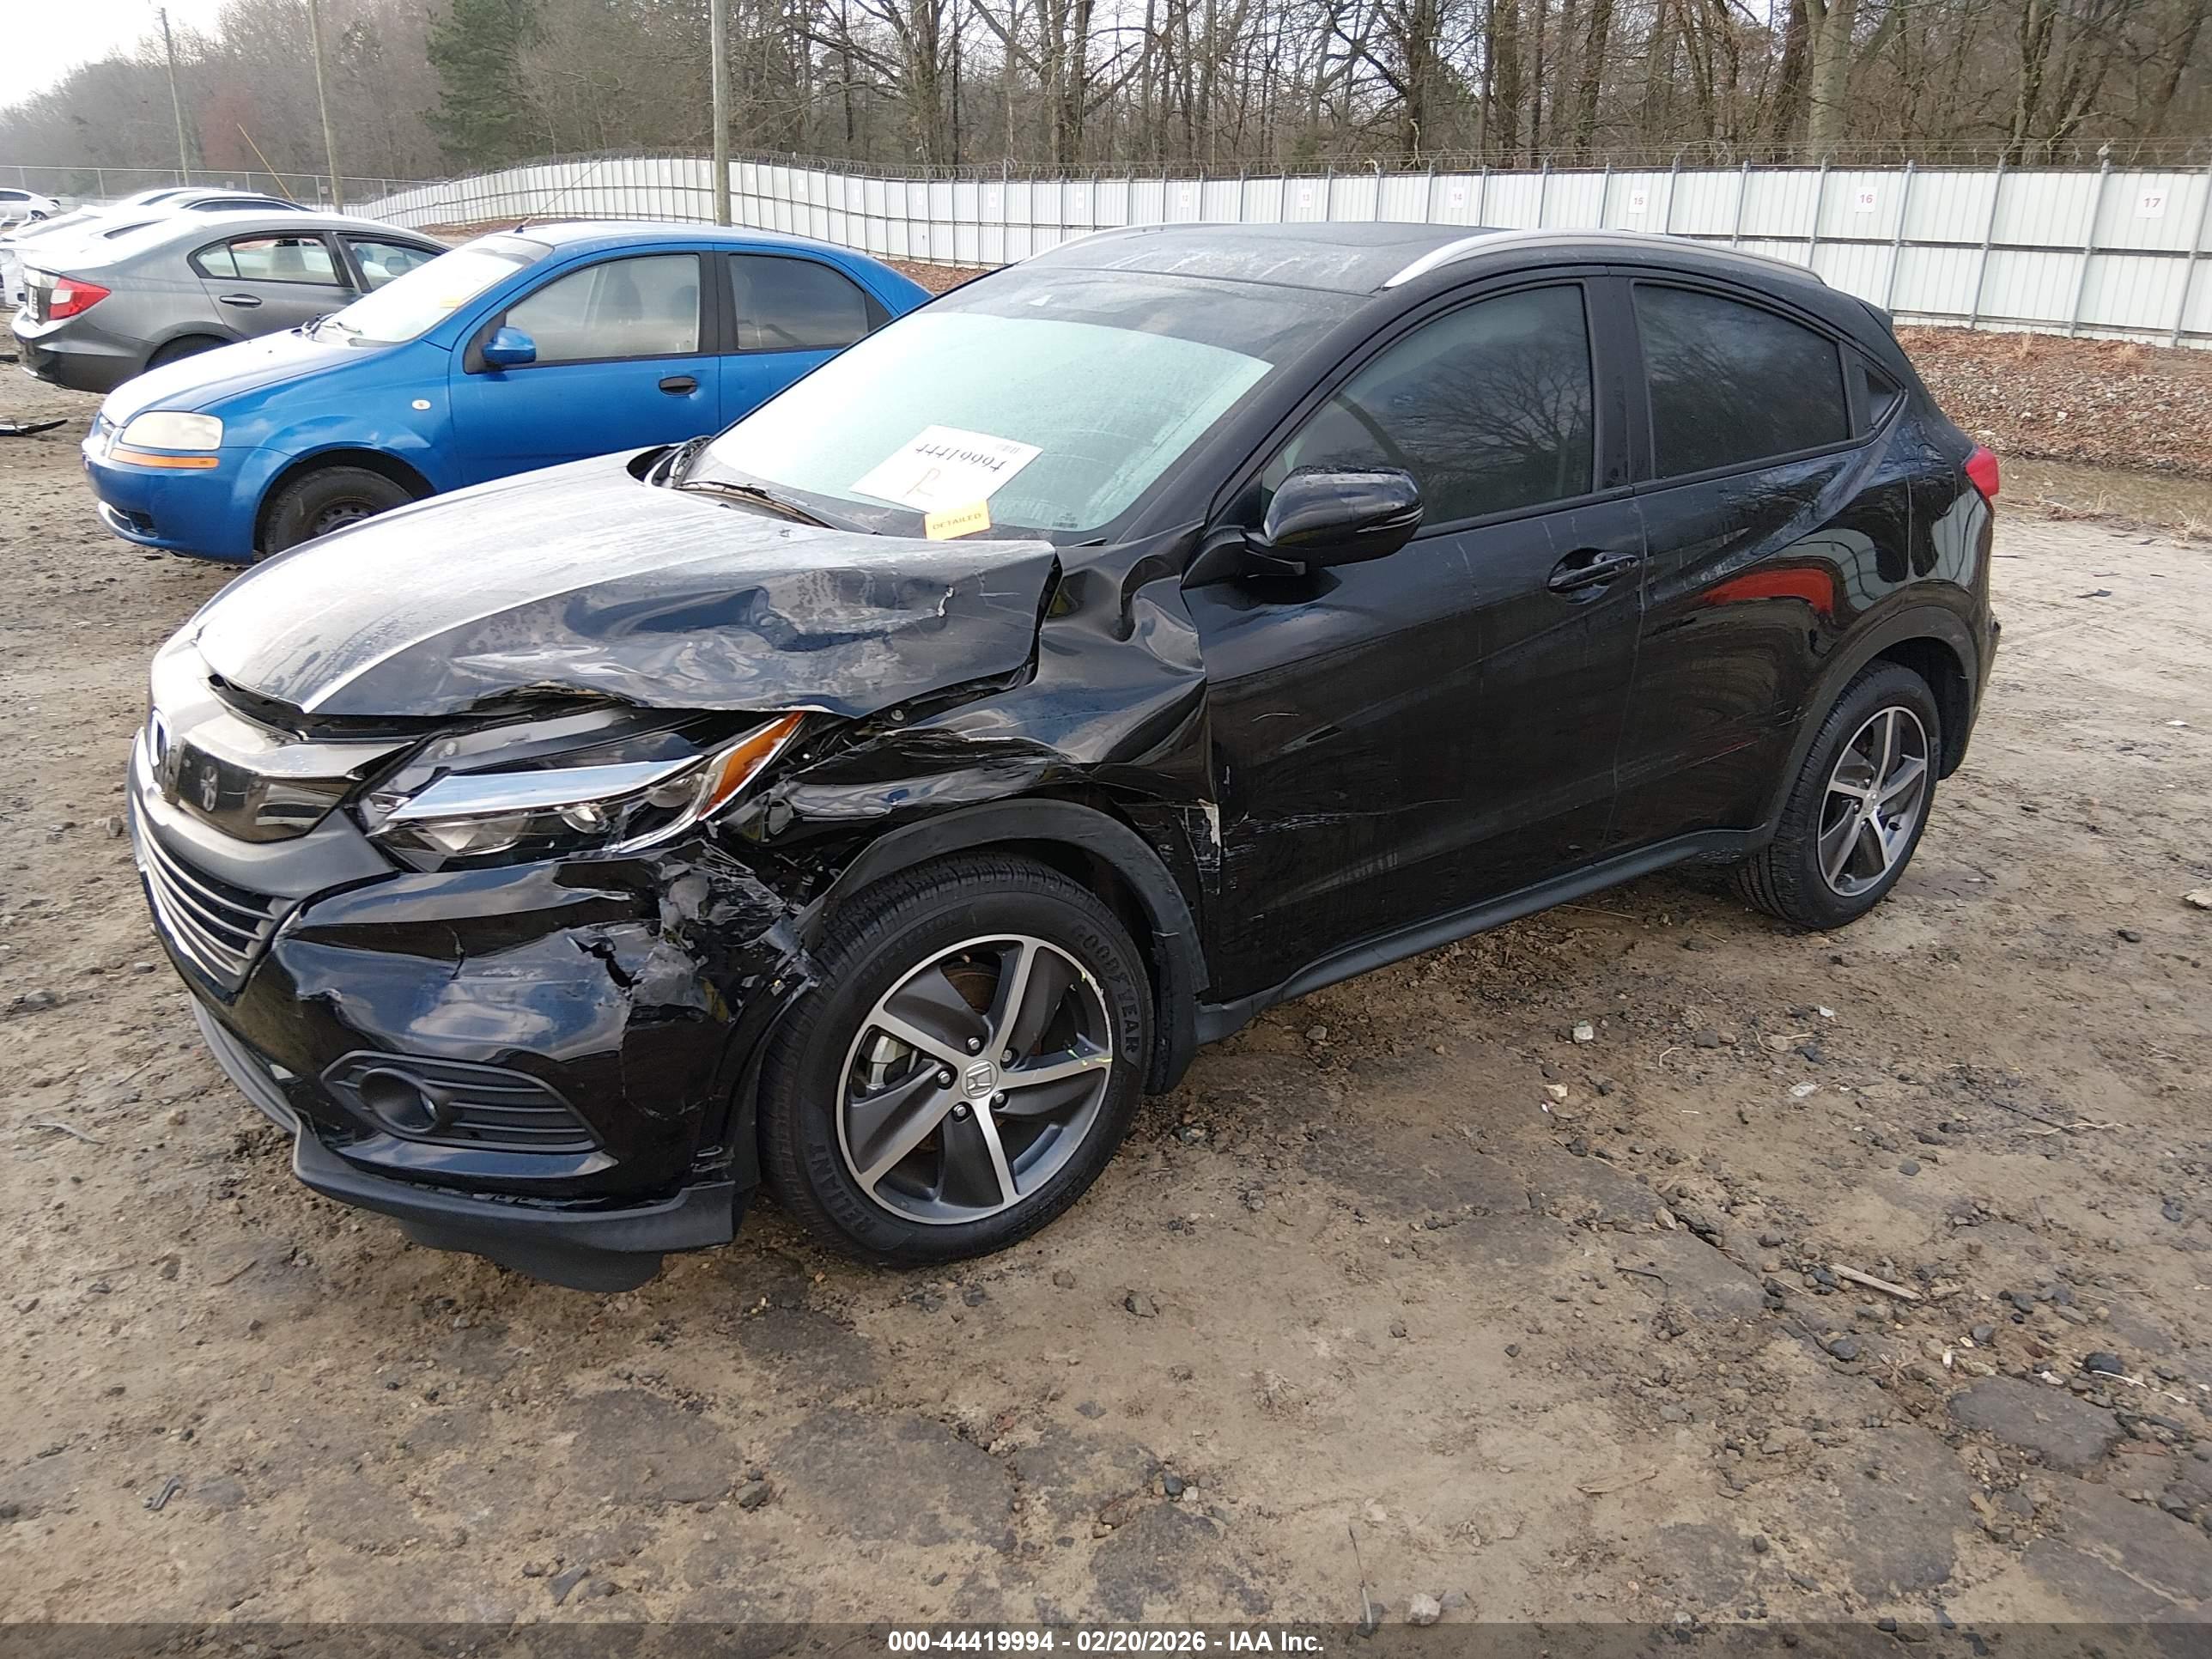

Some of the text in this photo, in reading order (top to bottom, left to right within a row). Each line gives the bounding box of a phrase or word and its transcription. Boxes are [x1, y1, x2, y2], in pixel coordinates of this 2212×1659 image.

[1453, 192, 1463, 202] 14
[1634, 196, 1644, 205] 15
[1859, 193, 1874, 204] 16
[2143, 198, 2160, 207] 17
[915, 443, 1008, 472] 44419994
[933, 513, 982, 530] DETAILED
[1072, 924, 1140, 1054] GOODYEAR
